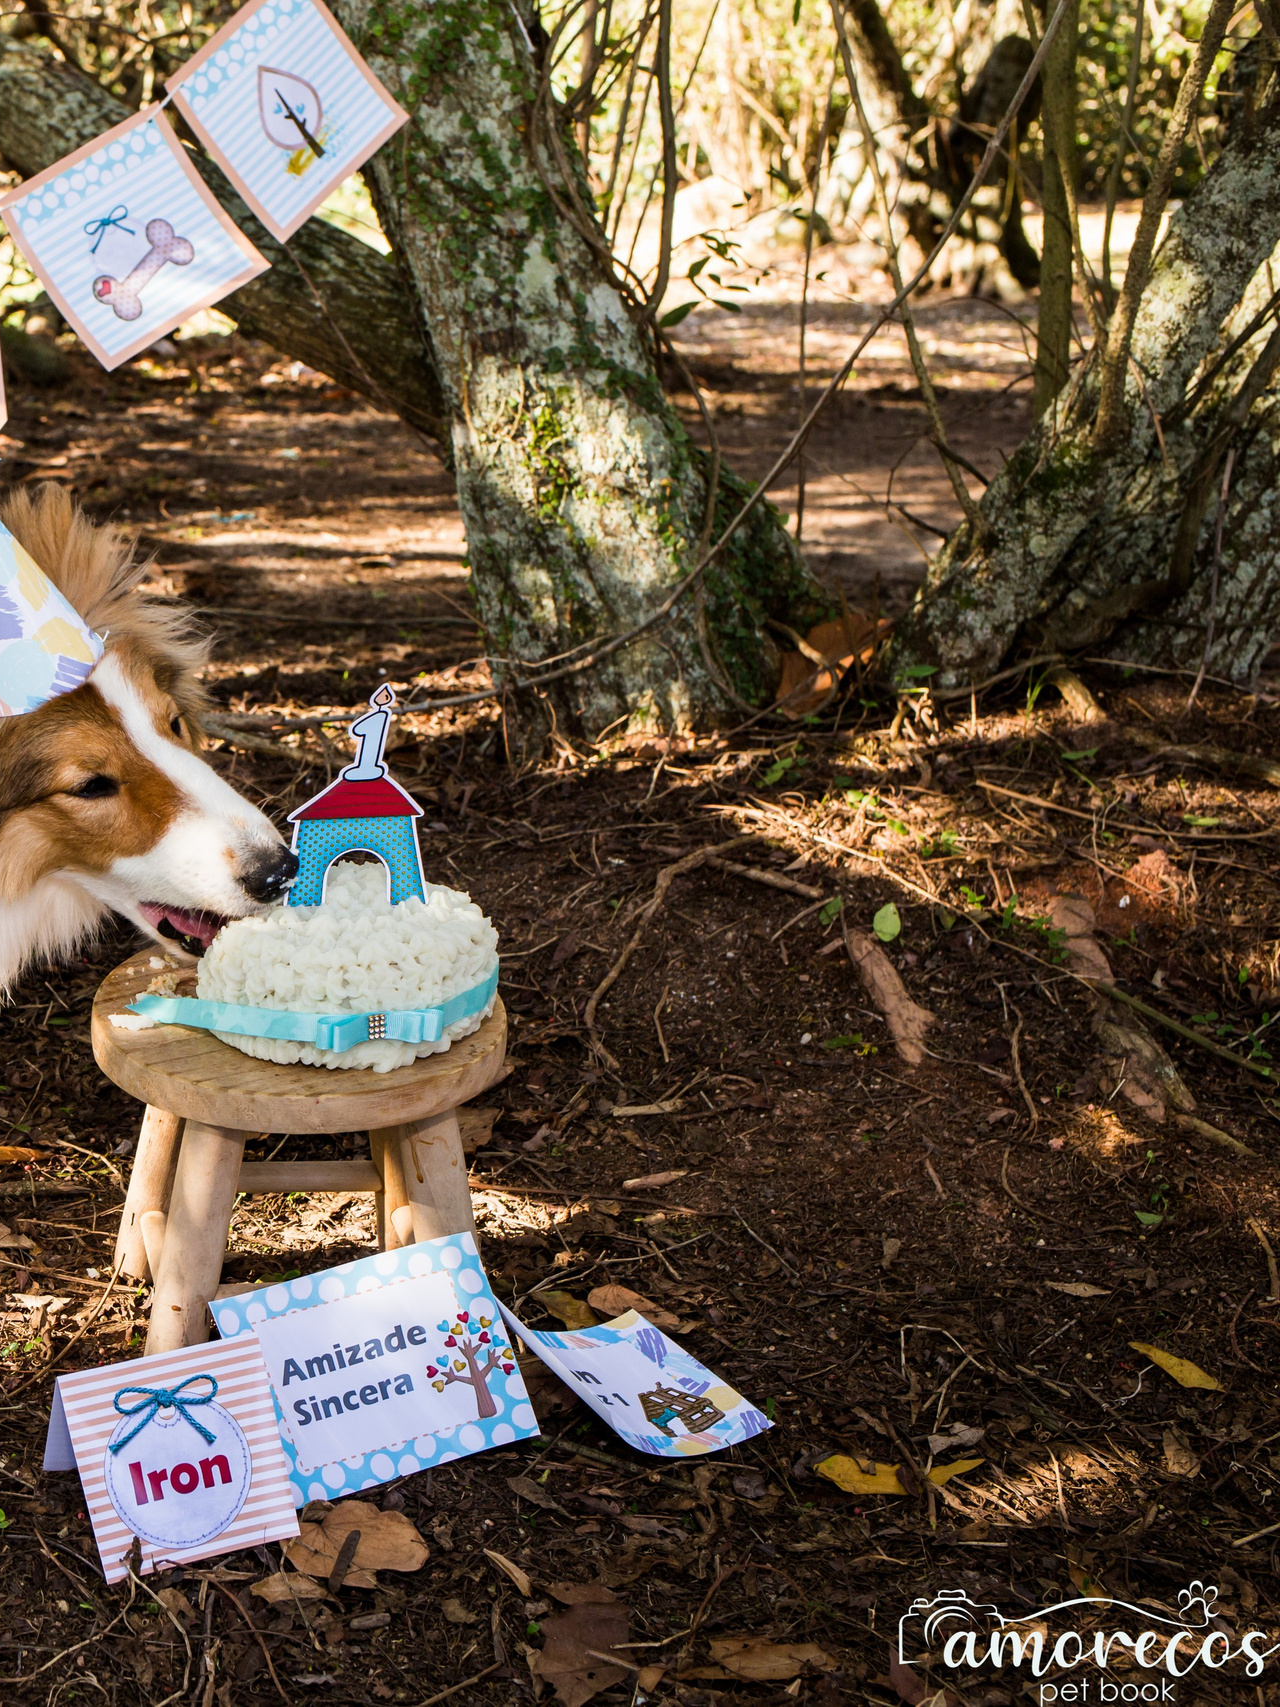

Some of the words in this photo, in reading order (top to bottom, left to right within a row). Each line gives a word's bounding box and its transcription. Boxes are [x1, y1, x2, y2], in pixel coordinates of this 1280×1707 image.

[343, 710, 385, 782] 1
[282, 1324, 427, 1387] Amizade
[293, 1373, 415, 1427] Sincera
[128, 1454, 233, 1506] Iron
